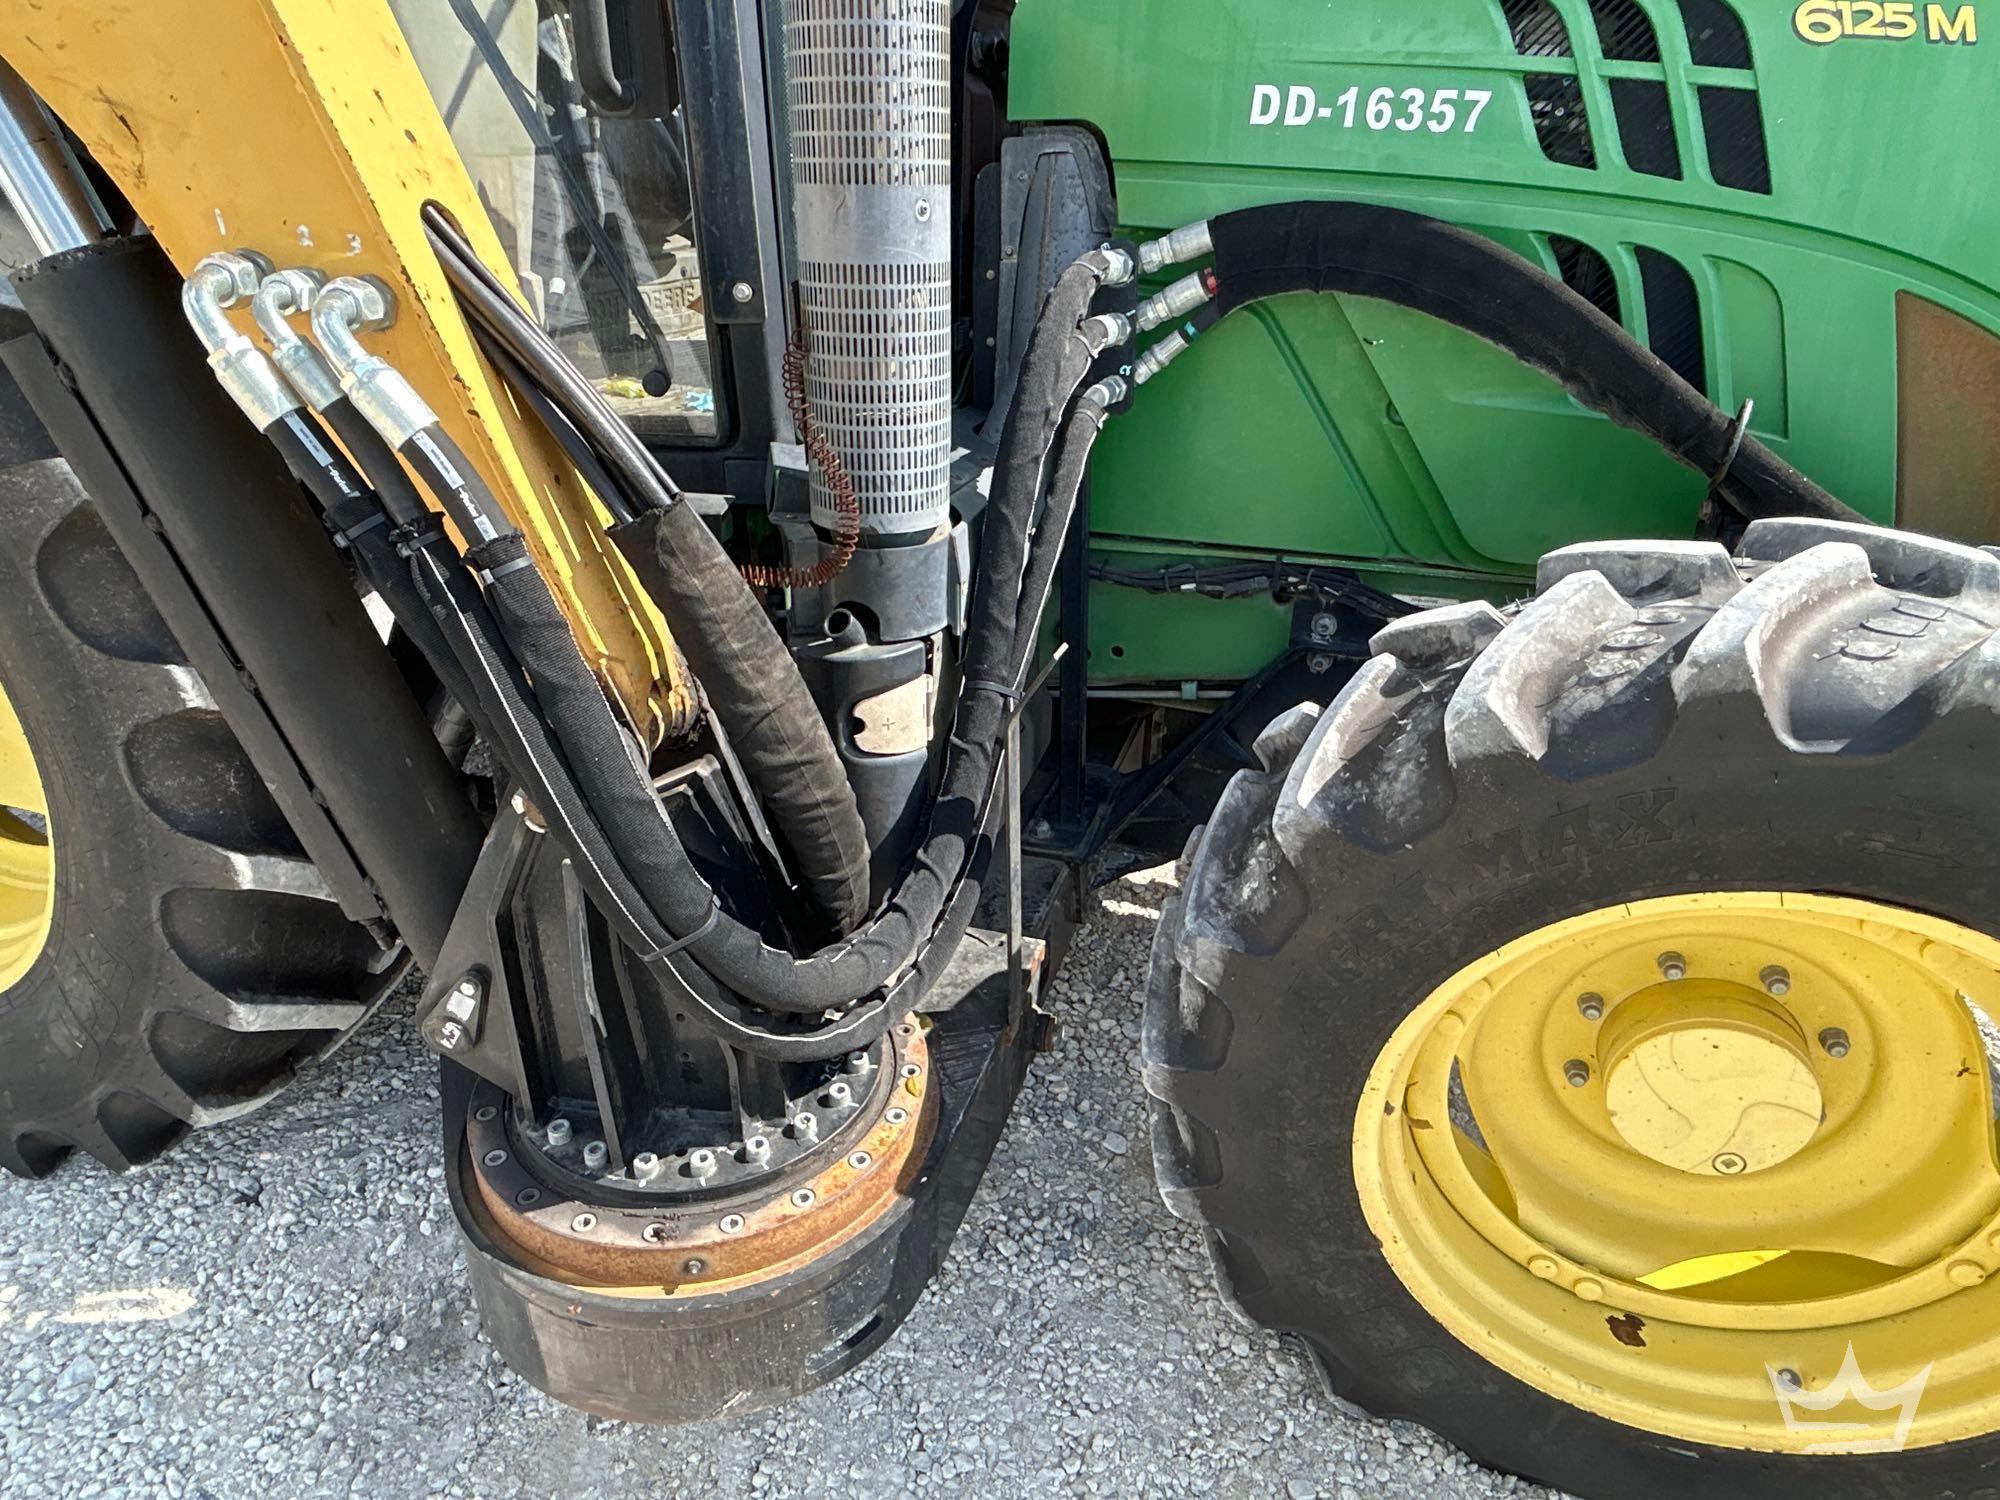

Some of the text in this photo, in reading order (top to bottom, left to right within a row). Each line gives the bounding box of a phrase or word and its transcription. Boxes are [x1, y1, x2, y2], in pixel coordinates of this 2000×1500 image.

[1792, 0, 1978, 46] 6125 M
[1249, 84, 1493, 133] DD-16357
